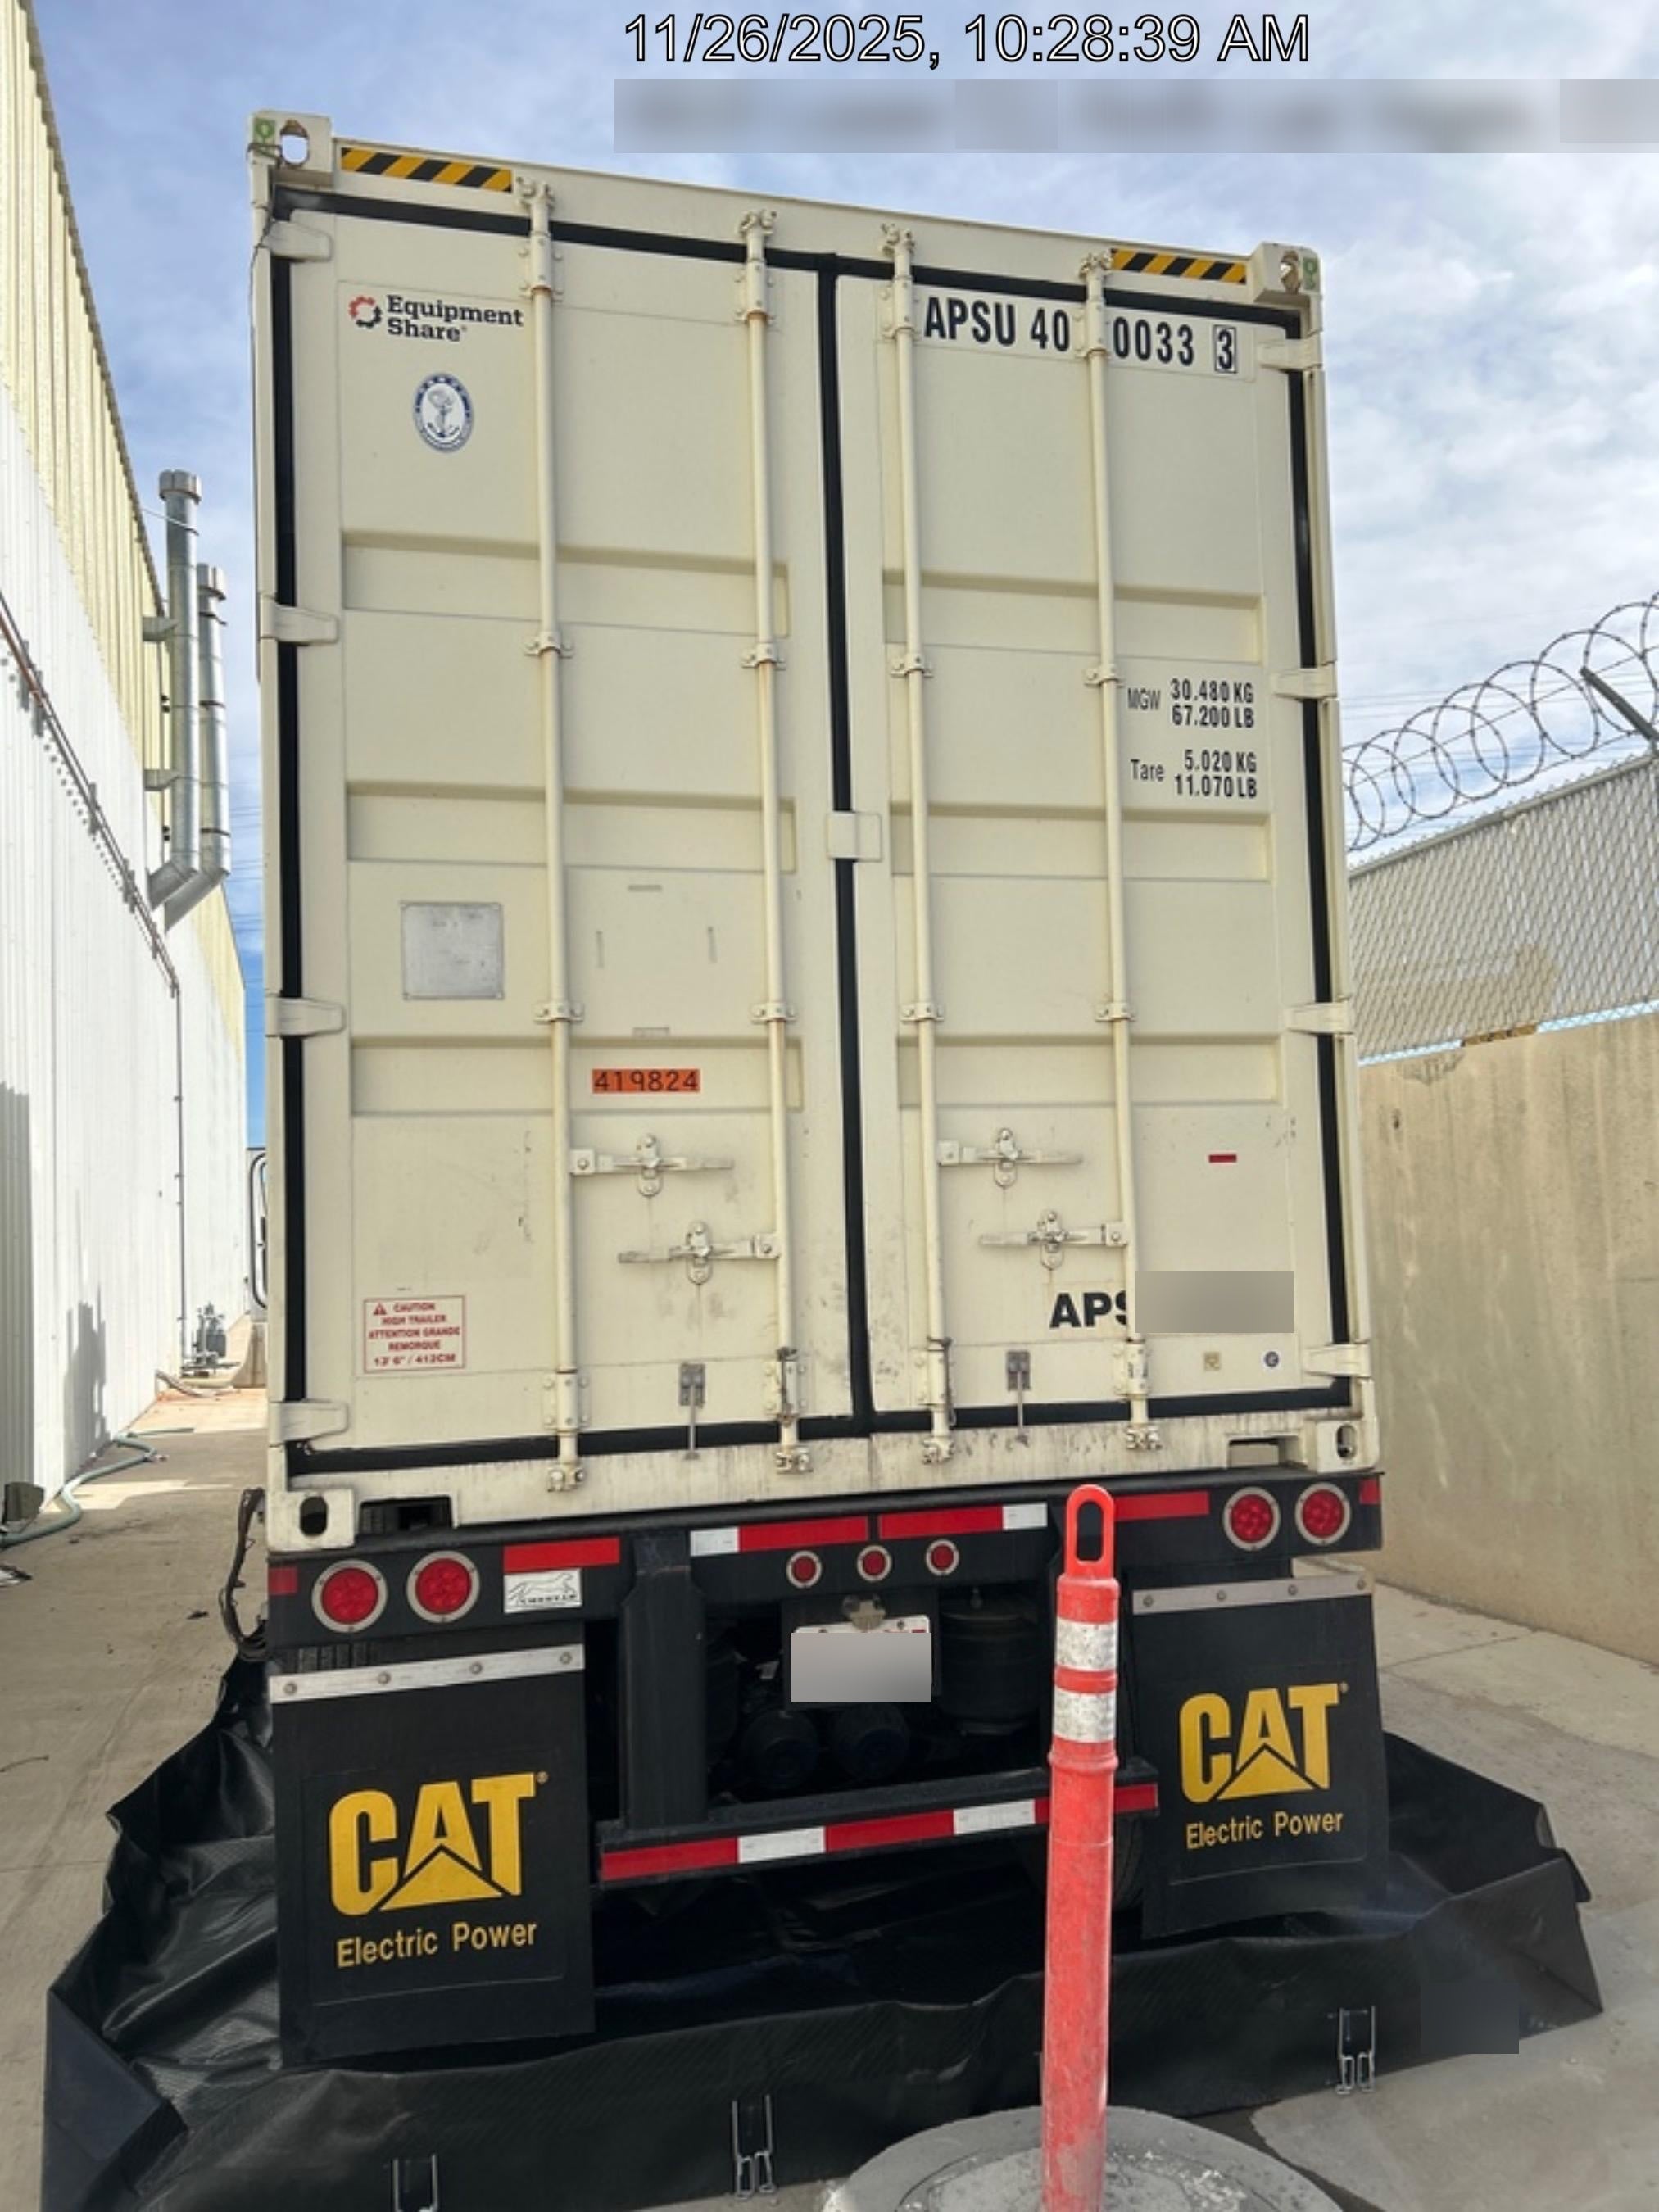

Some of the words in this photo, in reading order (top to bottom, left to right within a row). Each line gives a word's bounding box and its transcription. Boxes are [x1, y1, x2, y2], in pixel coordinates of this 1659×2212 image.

[387, 294, 524, 327] Equipment
[388, 317, 461, 342] Share
[923, 296, 1016, 347] APSU
[1030, 306, 1070, 353] 40
[1113, 316, 1194, 366] 0033
[1217, 329, 1235, 371] 3
[1127, 687, 1161, 710] MGW
[1170, 678, 1230, 703] 30.480
[1233, 682, 1253, 704] KG
[1172, 705, 1231, 728] 67.200
[1234, 708, 1254, 728] LB
[1130, 759, 1165, 782] Tare
[1184, 749, 1231, 773] 5.020
[1235, 751, 1257, 773] KG
[1174, 773, 1233, 797] 11.070
[1238, 777, 1258, 799] LB
[592, 1069, 699, 1093] 419824
[393, 1302, 435, 1312] CAUTION
[382, 1316, 406, 1325] HIGH
[408, 1314, 446, 1323] TRAILER
[369, 1328, 420, 1339] ATTENTION
[1186, 1815, 1264, 1850] Electric
[1274, 1811, 1344, 1838] Power
[336, 1927, 439, 1968] Electric
[452, 1921, 537, 1952] Power
